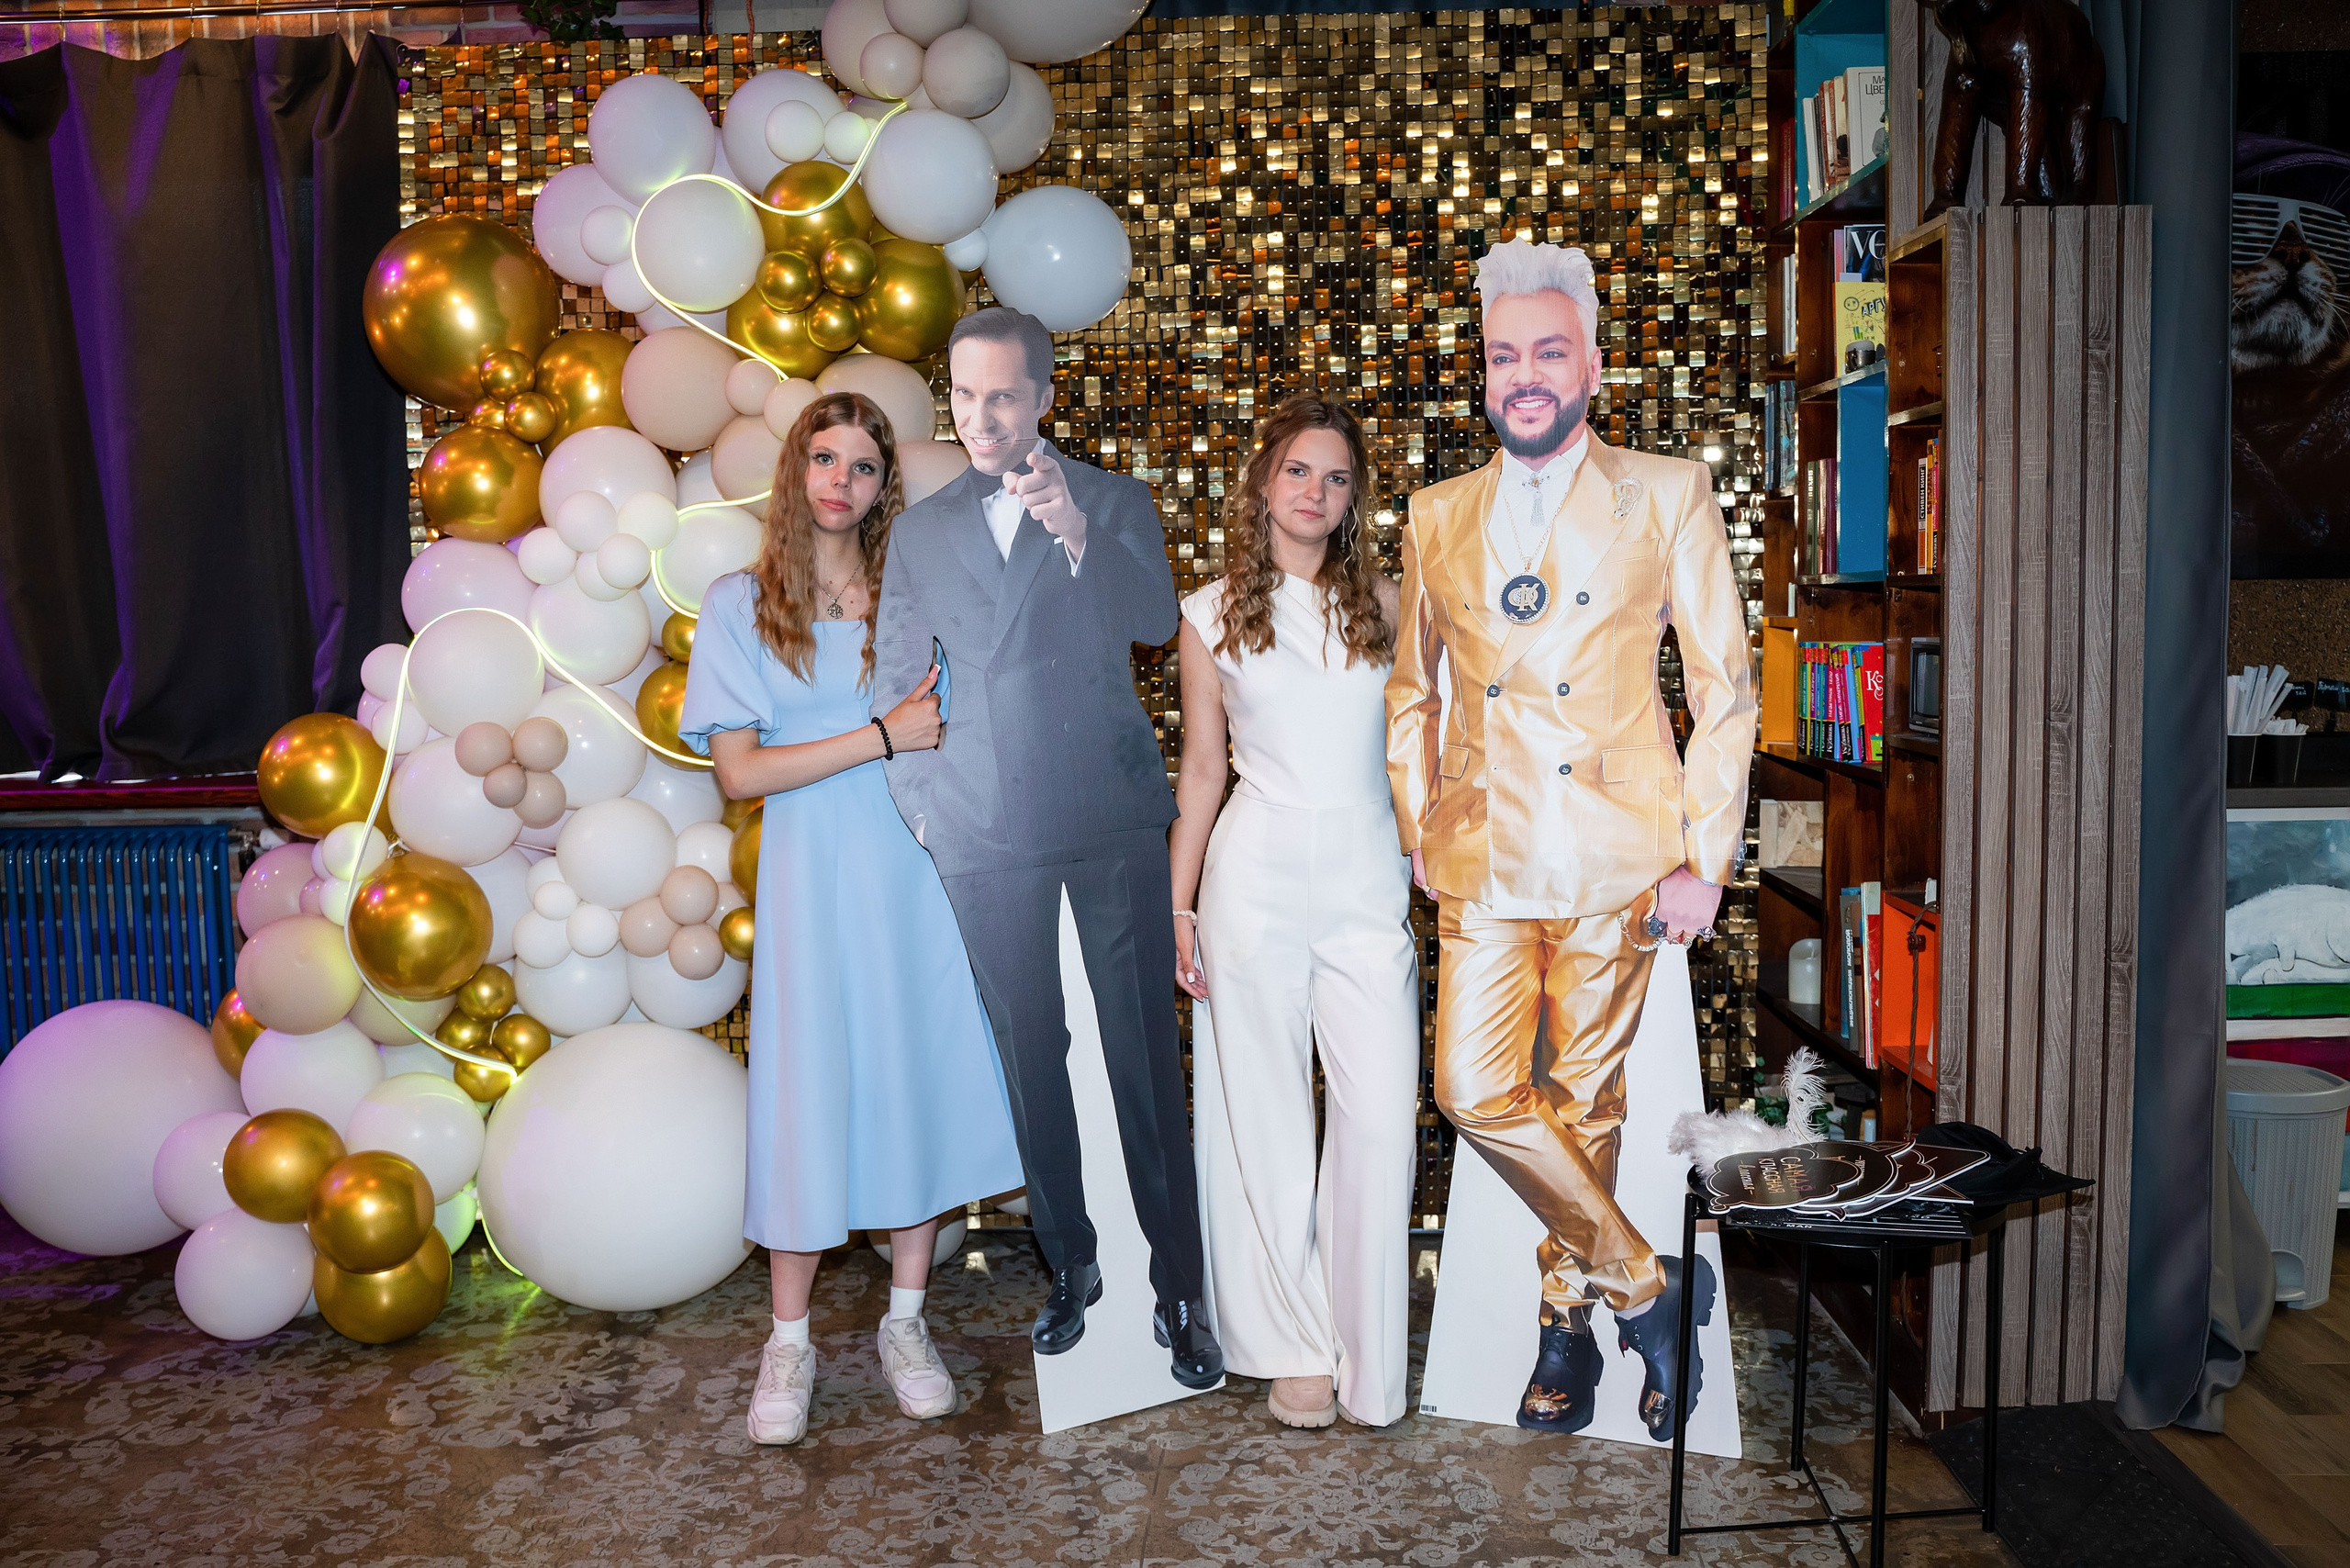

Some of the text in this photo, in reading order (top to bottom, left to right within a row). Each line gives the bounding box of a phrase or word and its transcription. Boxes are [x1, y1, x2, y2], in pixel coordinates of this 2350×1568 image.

[1844, 928, 1852, 967] МОЛОДОЙ
[1758, 1157, 1786, 1194] КЛАССНАЯ
[1779, 1156, 1814, 1193] САМАЯ
